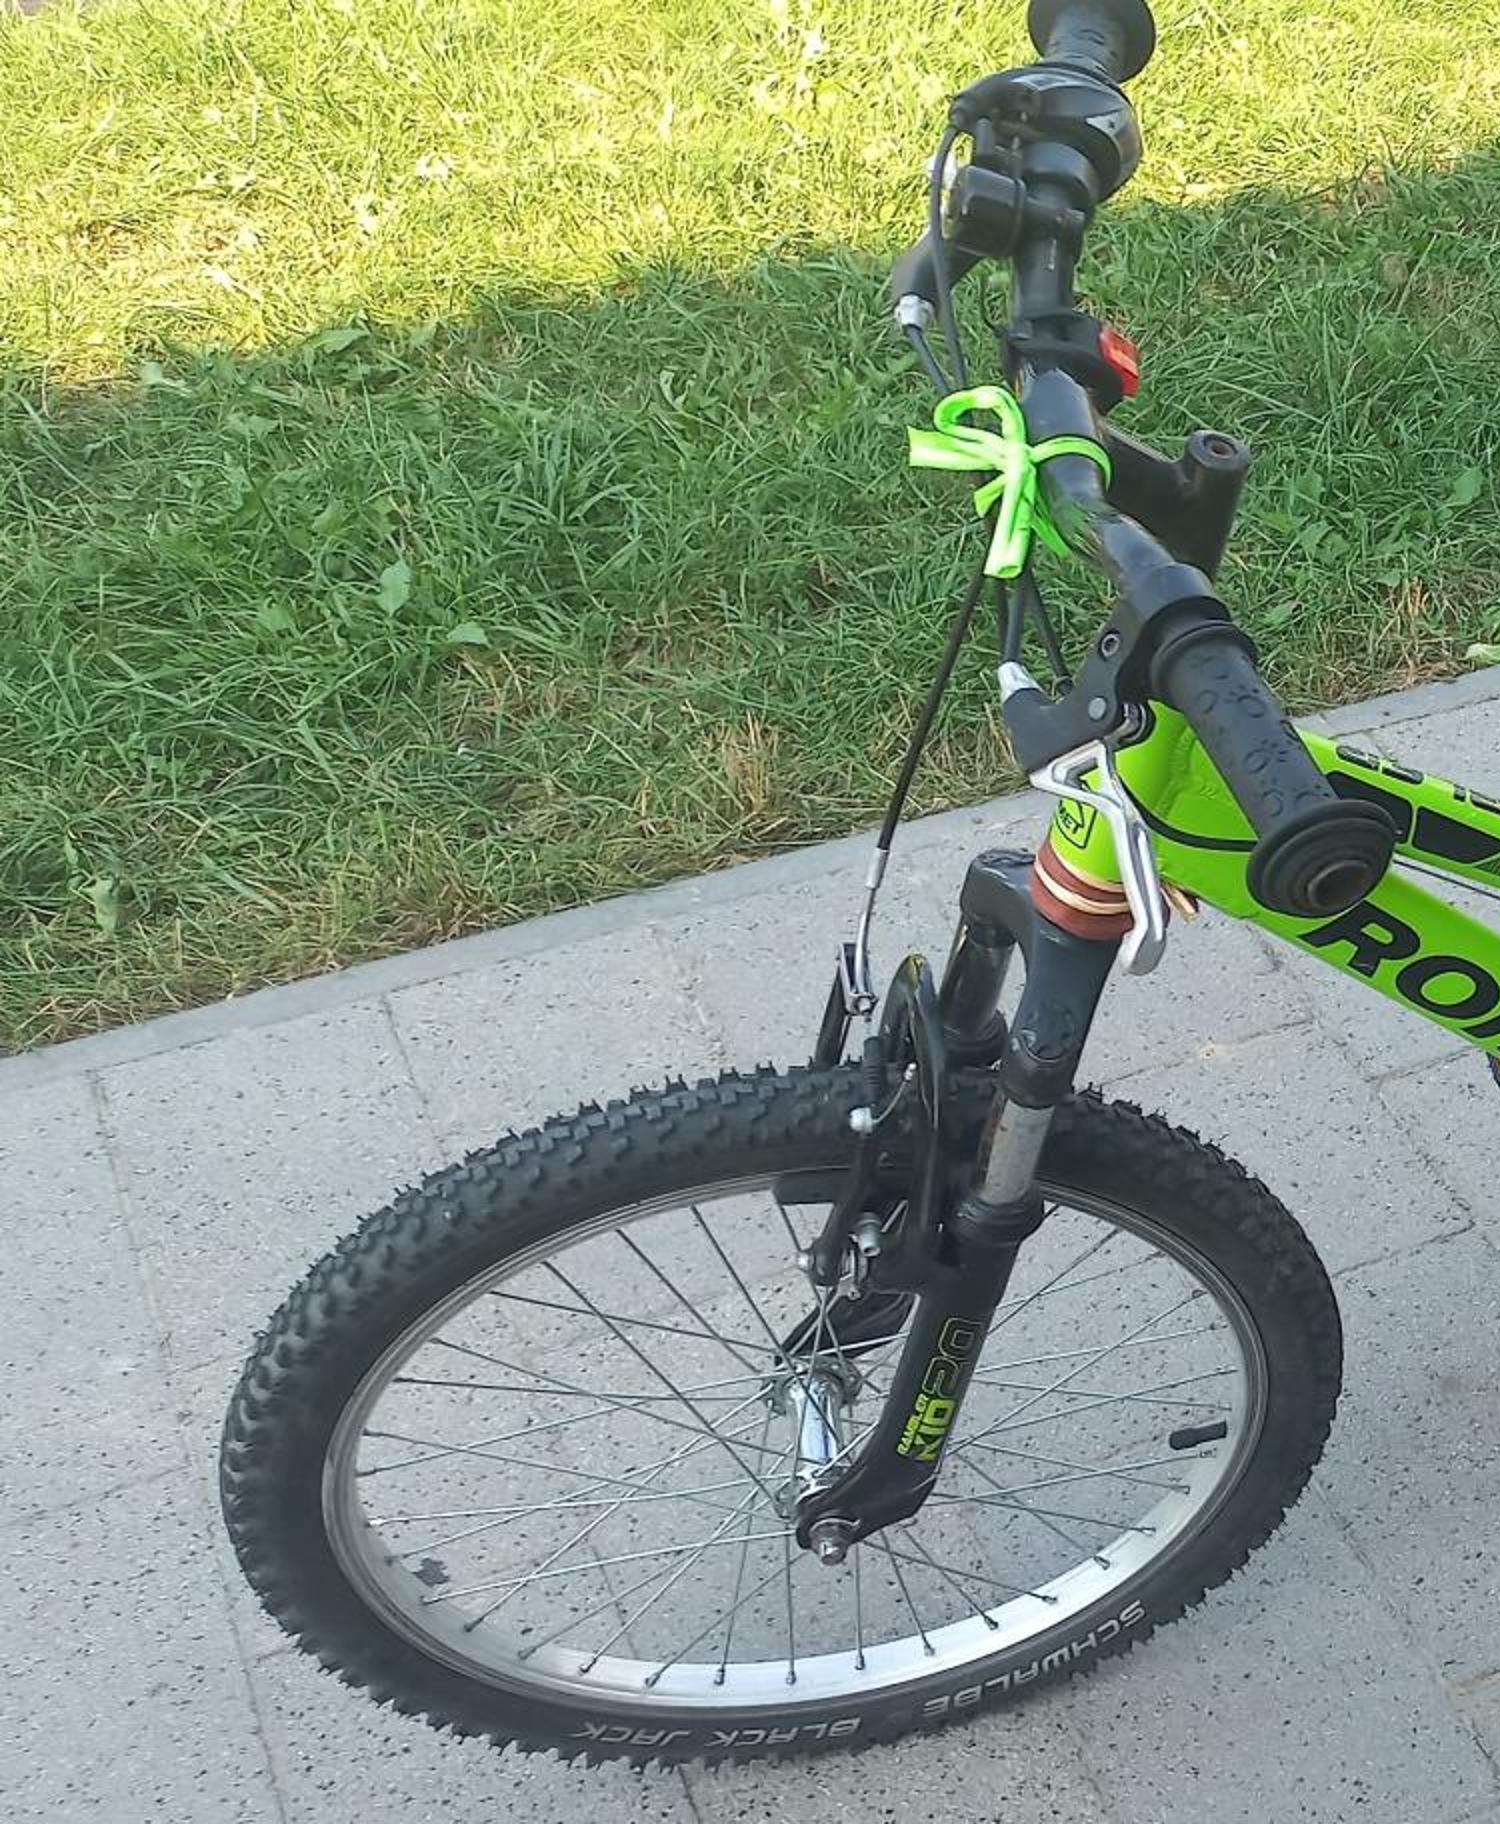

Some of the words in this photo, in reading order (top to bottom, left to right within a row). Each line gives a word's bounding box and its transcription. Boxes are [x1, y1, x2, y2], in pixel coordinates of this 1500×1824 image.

[922, 1599, 1147, 1718] SCHWALBE
[570, 1721, 692, 1747] JACK
[704, 1716, 861, 1747] BLACK
